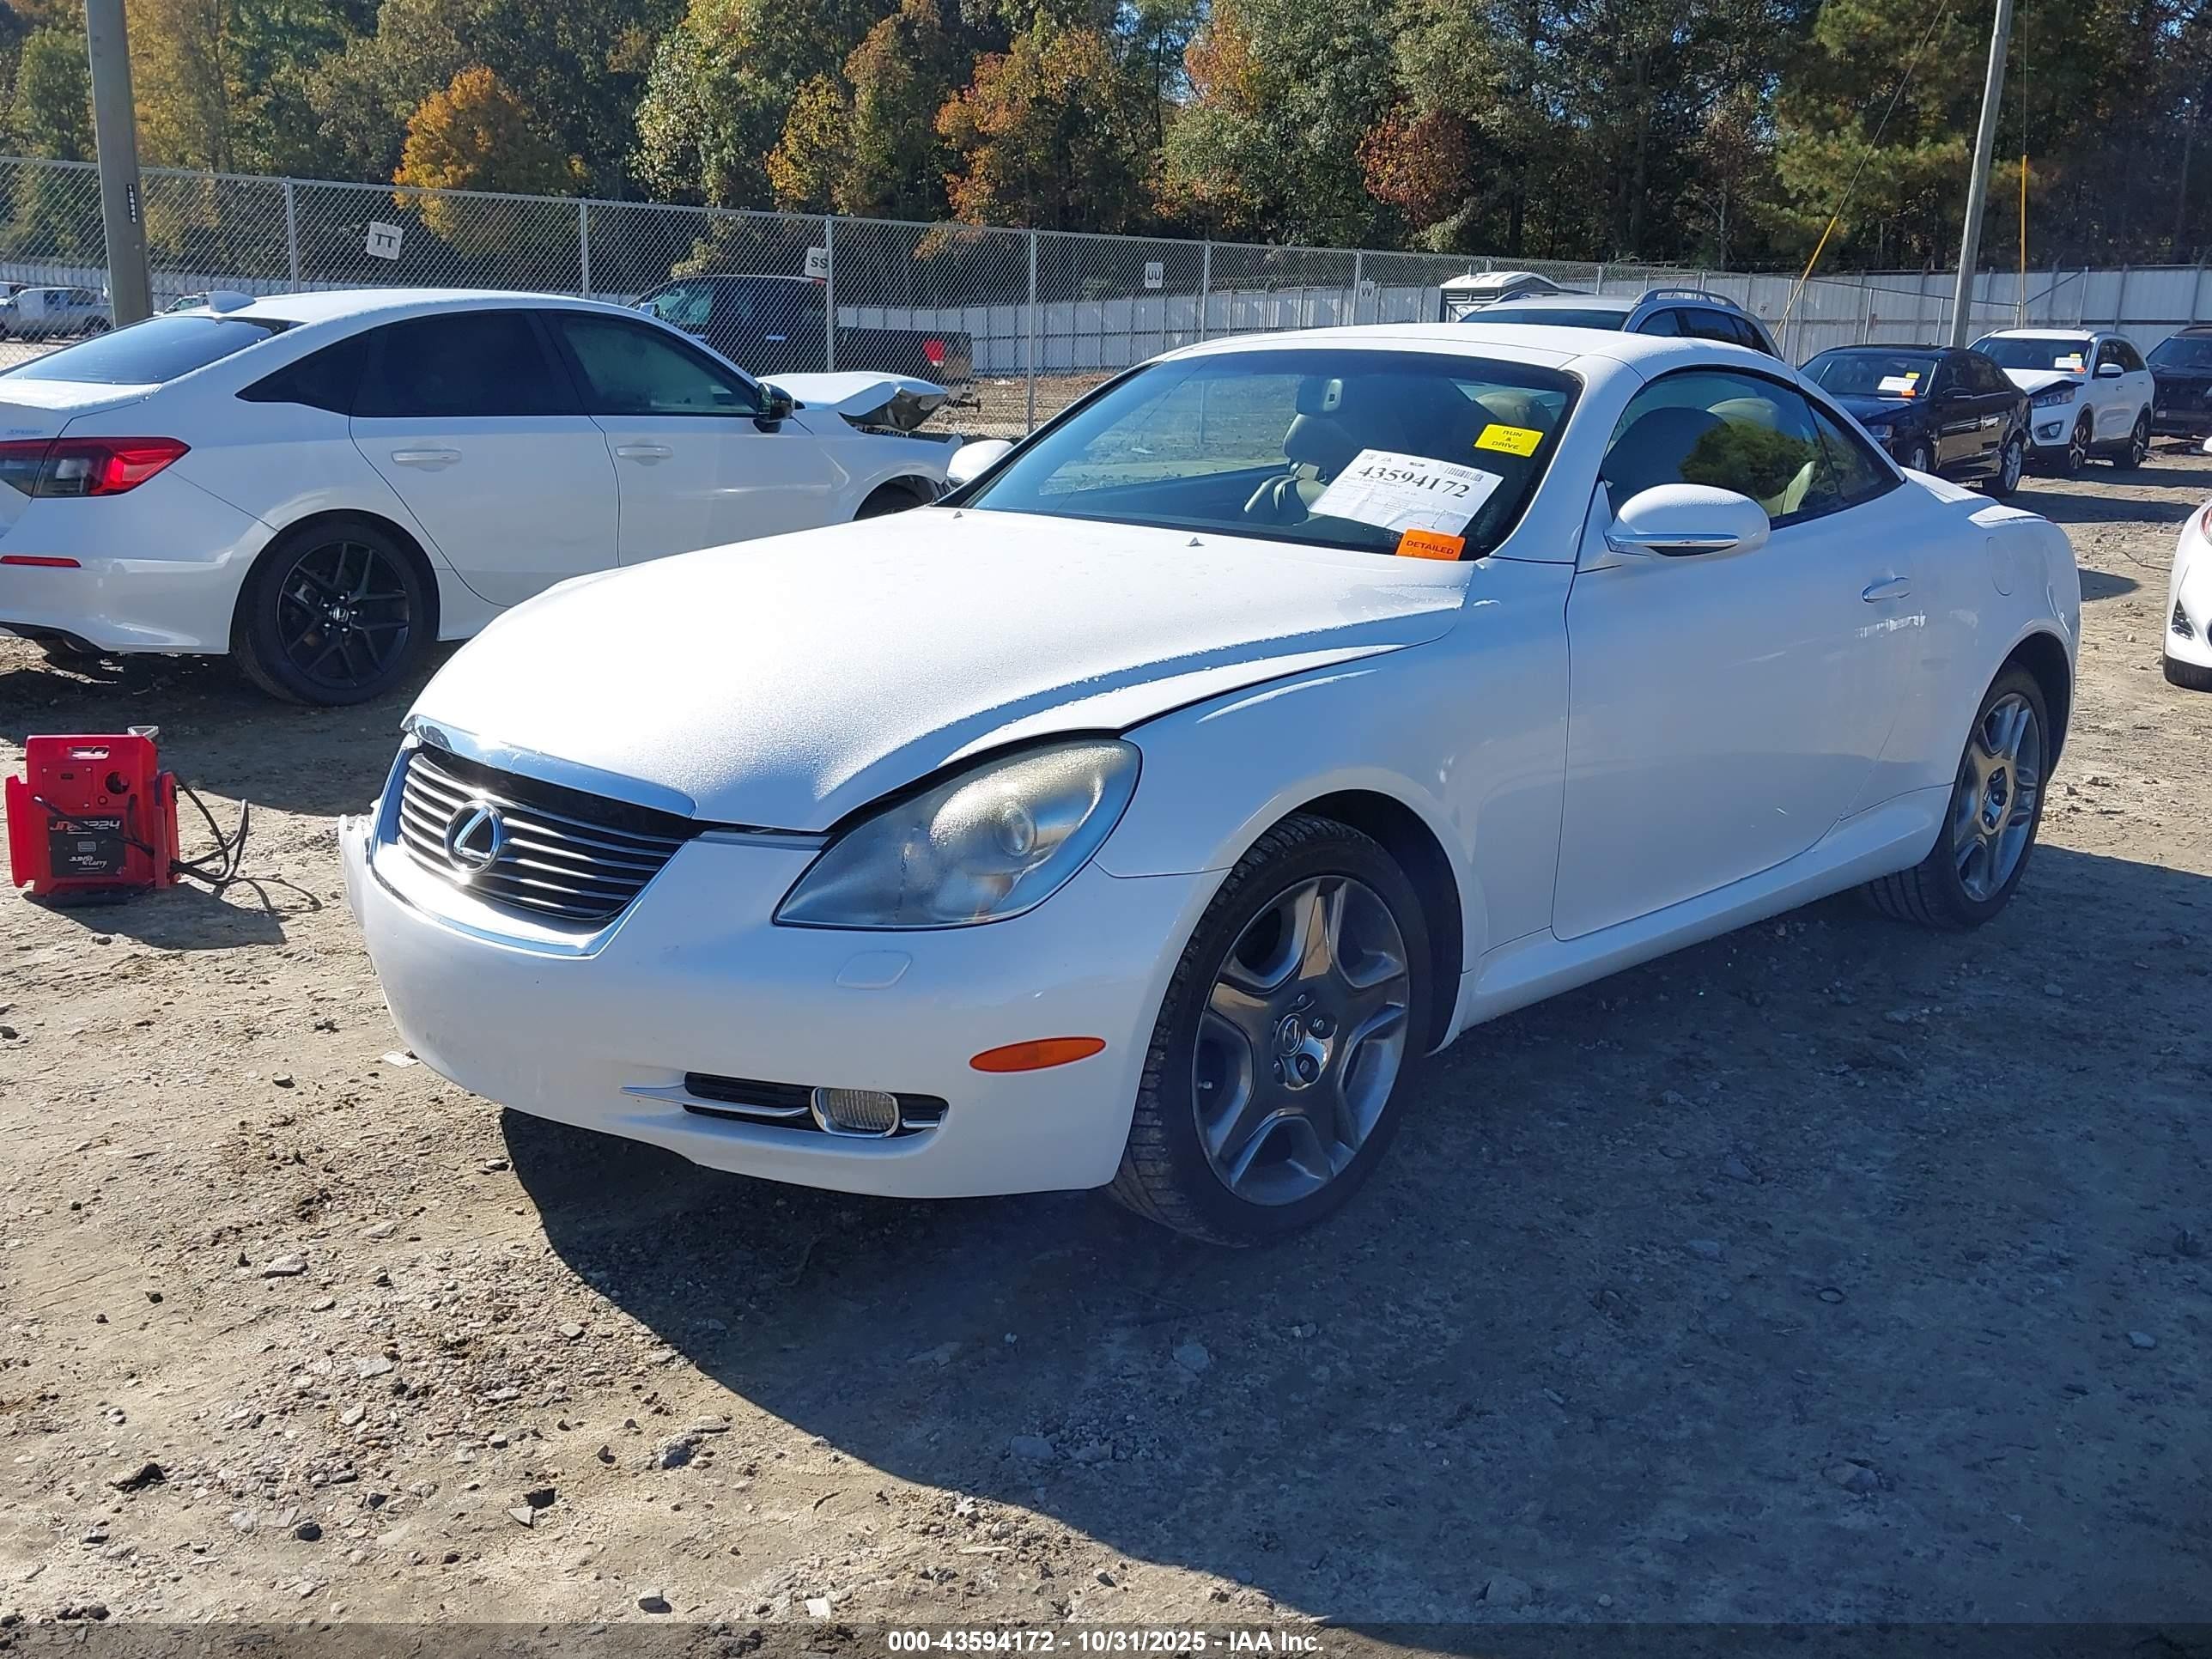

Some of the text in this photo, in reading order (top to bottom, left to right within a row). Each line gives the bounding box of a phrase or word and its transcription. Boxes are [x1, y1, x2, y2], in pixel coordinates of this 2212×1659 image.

[374, 232, 397, 248] TT
[810, 256, 829, 270] SS
[1147, 270, 1162, 280] UU
[1491, 441, 1520, 450] DRIVE
[1358, 465, 1471, 499] 43594172
[1406, 540, 1455, 555] DETAILED
